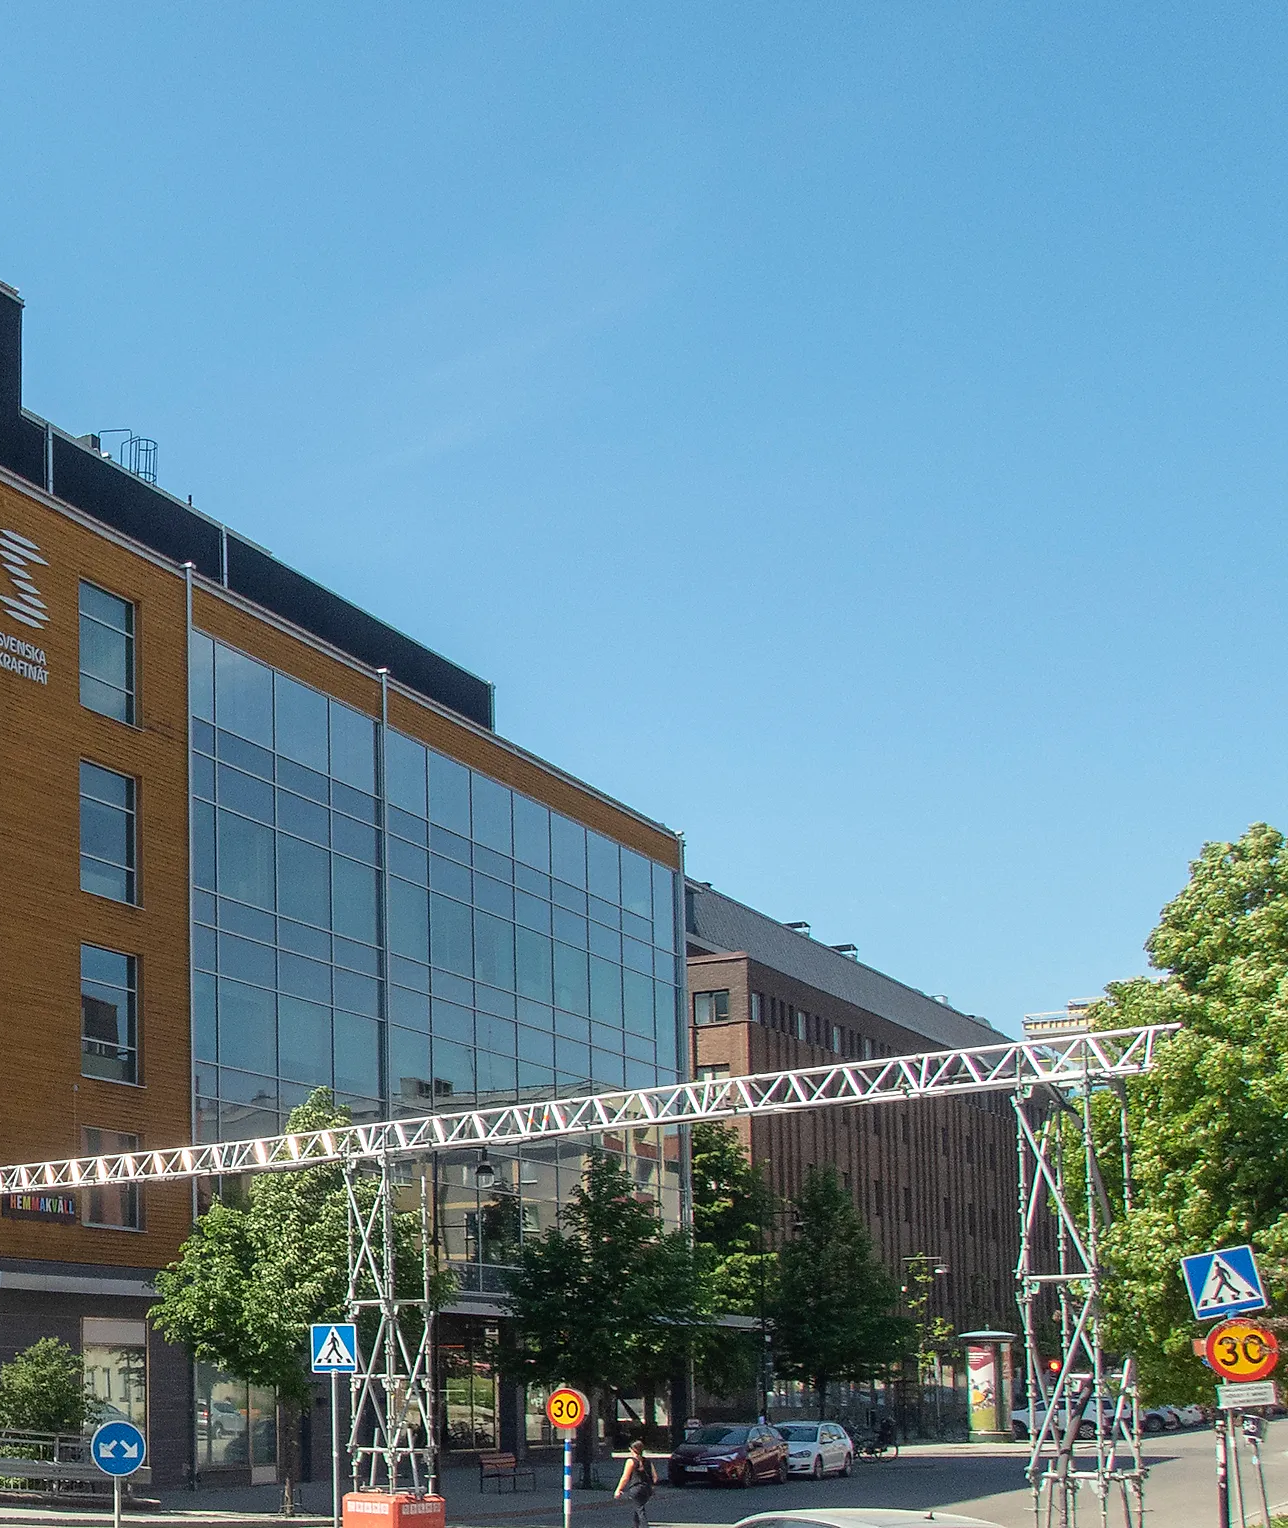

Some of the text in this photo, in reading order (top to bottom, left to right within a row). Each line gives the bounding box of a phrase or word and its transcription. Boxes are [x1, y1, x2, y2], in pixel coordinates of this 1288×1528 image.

[9, 1194, 75, 1215] HEMMAKVÄLL
[1219, 1334, 1266, 1367] 30
[553, 1399, 578, 1419] 30
